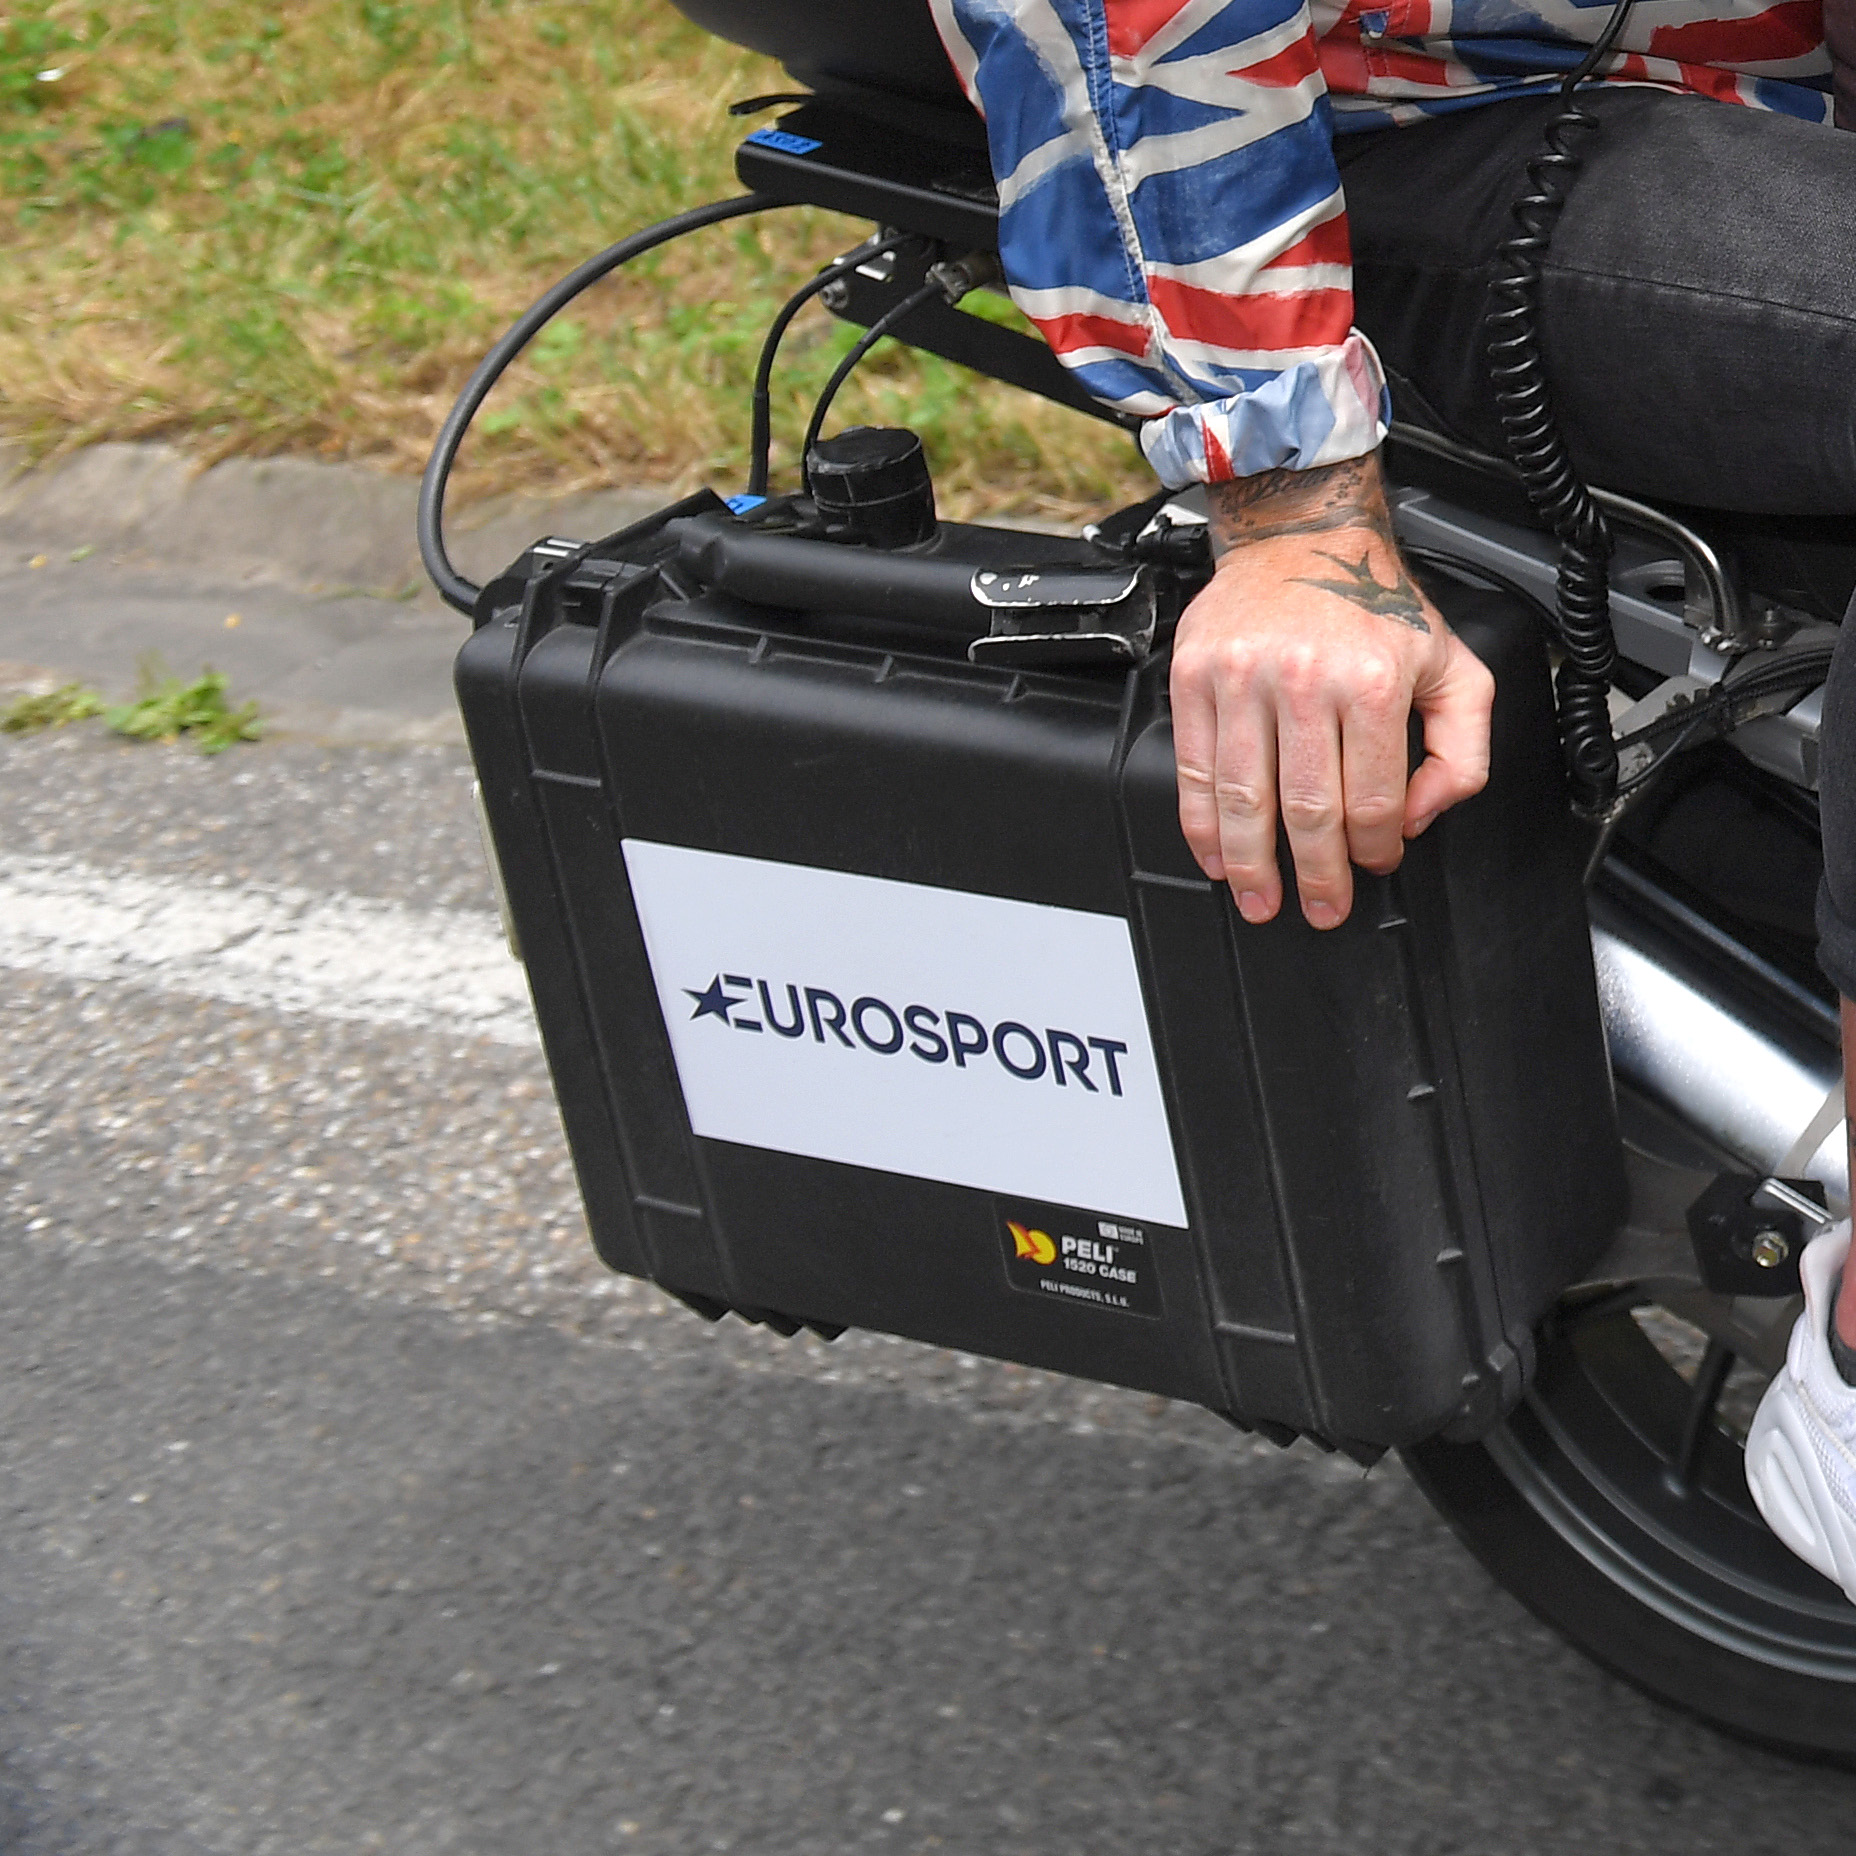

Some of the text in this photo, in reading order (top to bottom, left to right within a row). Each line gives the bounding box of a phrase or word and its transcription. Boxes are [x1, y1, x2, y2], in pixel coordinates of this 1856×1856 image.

[682, 971, 1129, 1098] EUROSPORT
[1061, 1234, 1114, 1264] PELI
[1063, 1256, 1096, 1275] 1520
